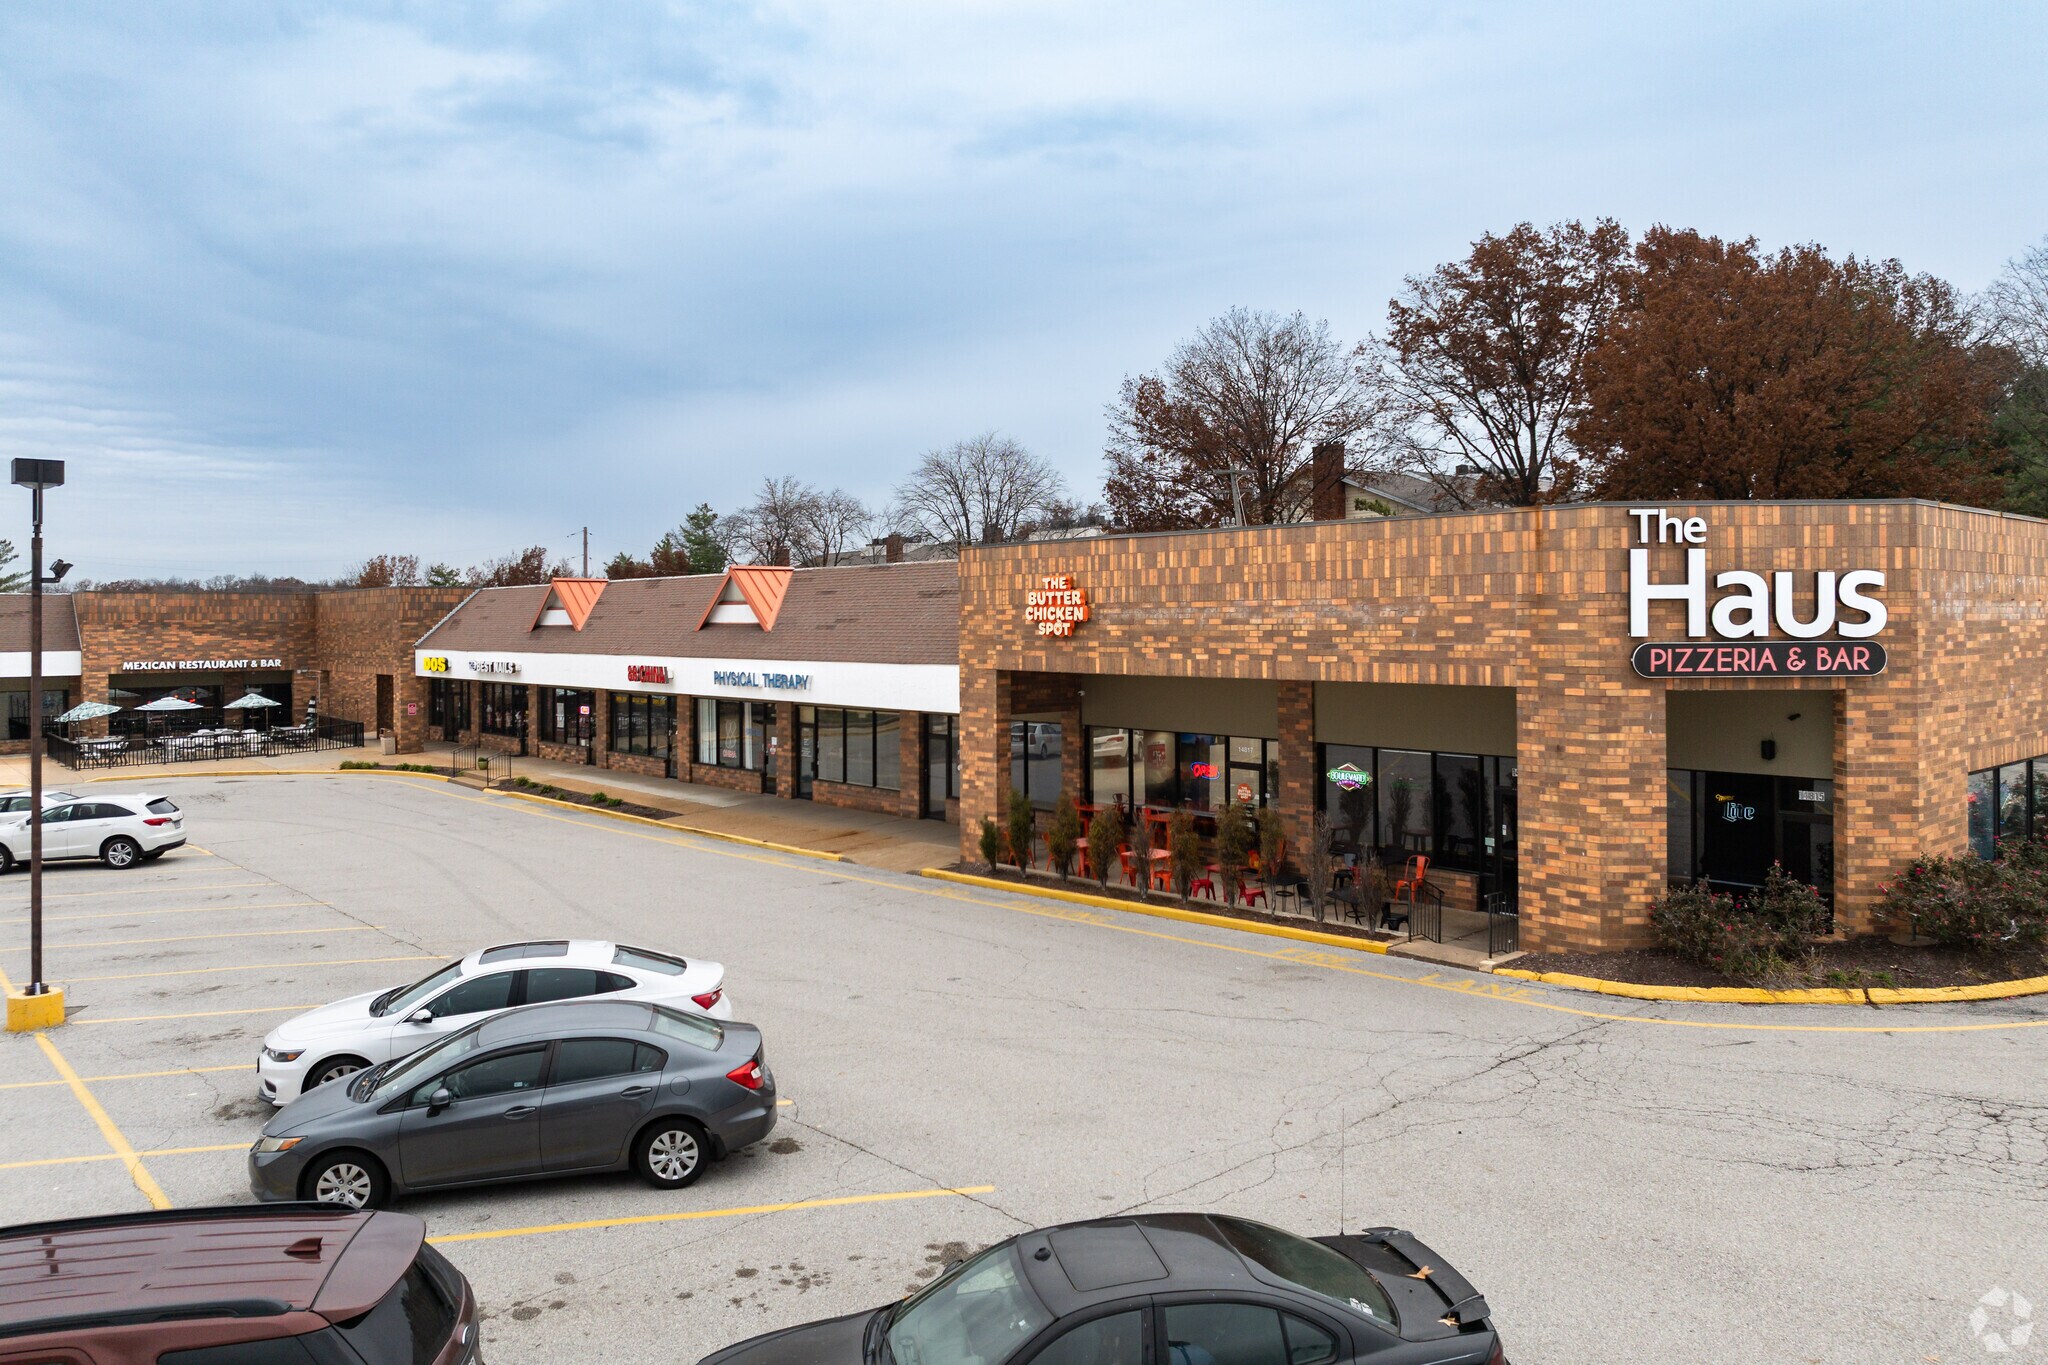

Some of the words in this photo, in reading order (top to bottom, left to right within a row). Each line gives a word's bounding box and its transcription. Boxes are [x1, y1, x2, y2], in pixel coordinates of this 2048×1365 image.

[1629, 508, 1707, 543] The
[1042, 577, 1067, 589] THE
[1028, 590, 1081, 605] BUTTER
[1630, 548, 1888, 638] Haus
[1025, 606, 1084, 620] CHICKEN
[1038, 621, 1070, 636] SPOT
[122, 661, 176, 670] MEXICAN
[178, 660, 248, 670] RESTAURANT
[250, 660, 257, 668] &
[260, 659, 282, 668] BAR
[423, 657, 446, 672] DOS
[1650, 648, 1778, 673] PIZZERIA
[1786, 647, 1807, 671] &
[1816, 646, 1870, 671] BAR
[713, 670, 759, 687] PHYSICAL
[762, 673, 809, 690] THERAPY
[1193, 763, 1218, 778] OPEN
